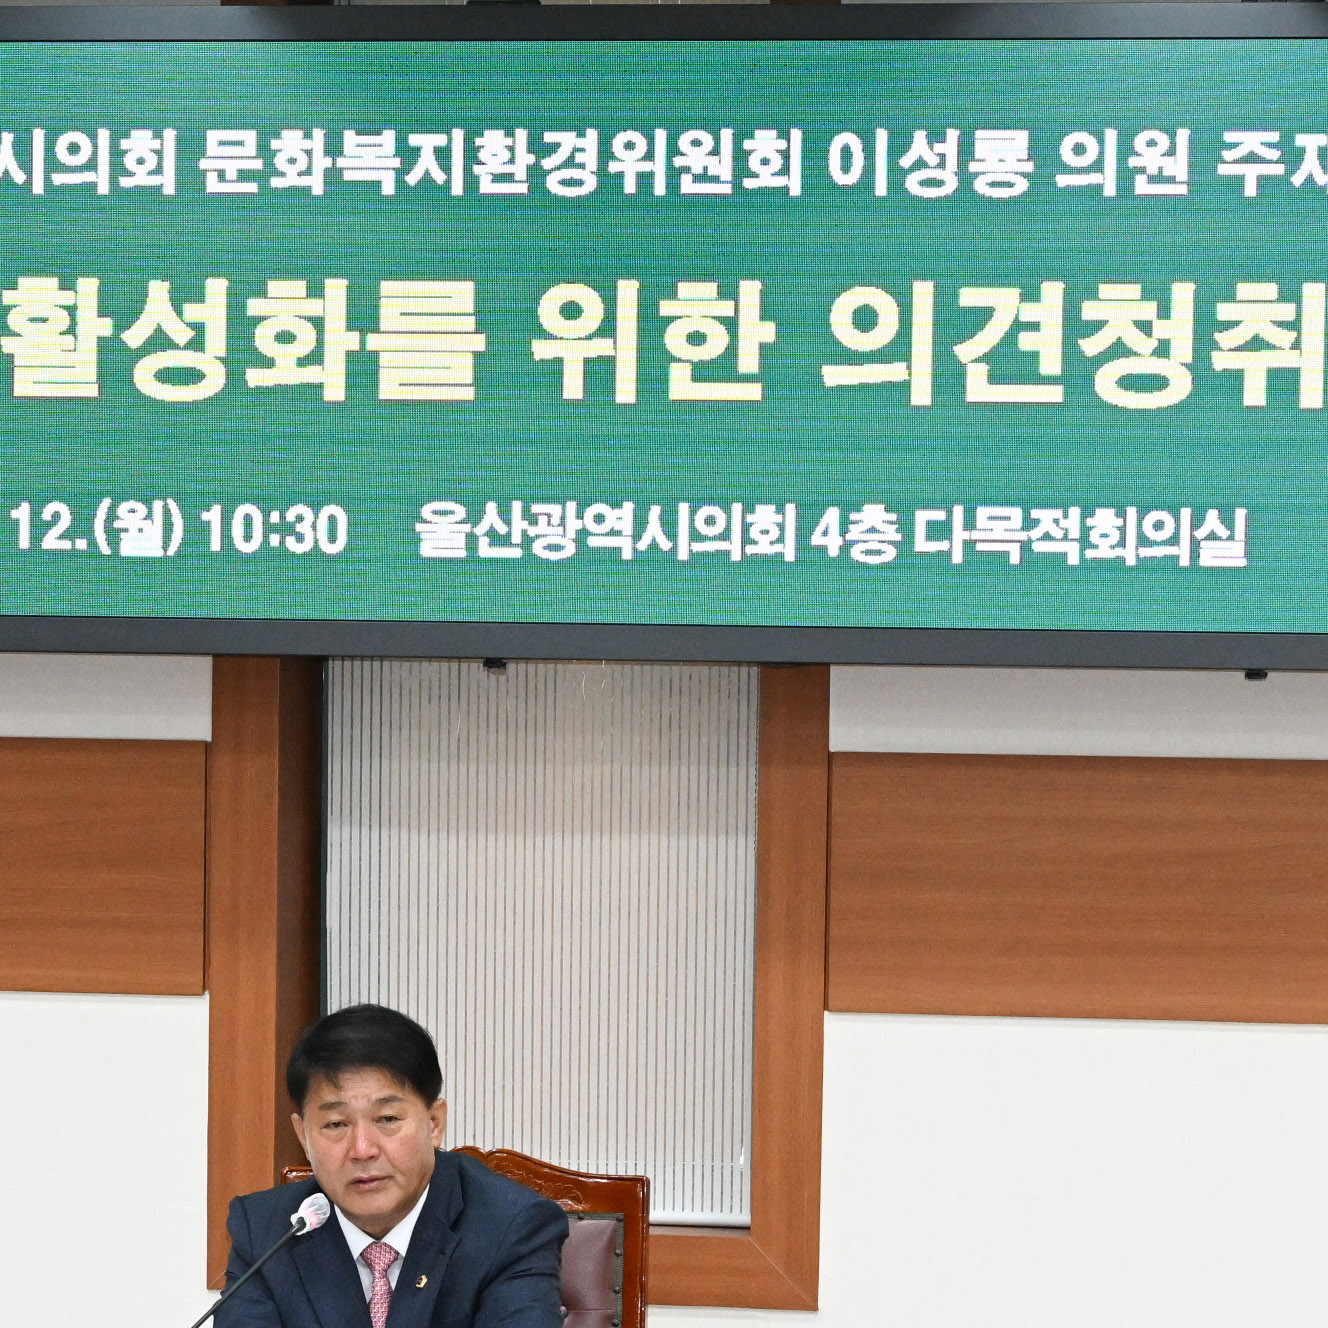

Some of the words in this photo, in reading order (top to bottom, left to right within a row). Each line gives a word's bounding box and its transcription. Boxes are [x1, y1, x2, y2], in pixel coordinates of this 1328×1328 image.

[198, 128, 803, 198] 문화복지환경위원회
[828, 128, 1035, 199] 이성룡
[1055, 128, 1191, 197] 의원
[0, 276, 486, 403] 활성화를
[531, 279, 777, 404] 위한
[821, 280, 1326, 410] 의견청취
[10, 498, 184, 558] 12.(월)
[201, 503, 349, 555] 10:30
[414, 500, 797, 562] 울산광역시의회
[810, 503, 902, 565] 4층
[914, 504, 1248, 568] 다목적회의실
